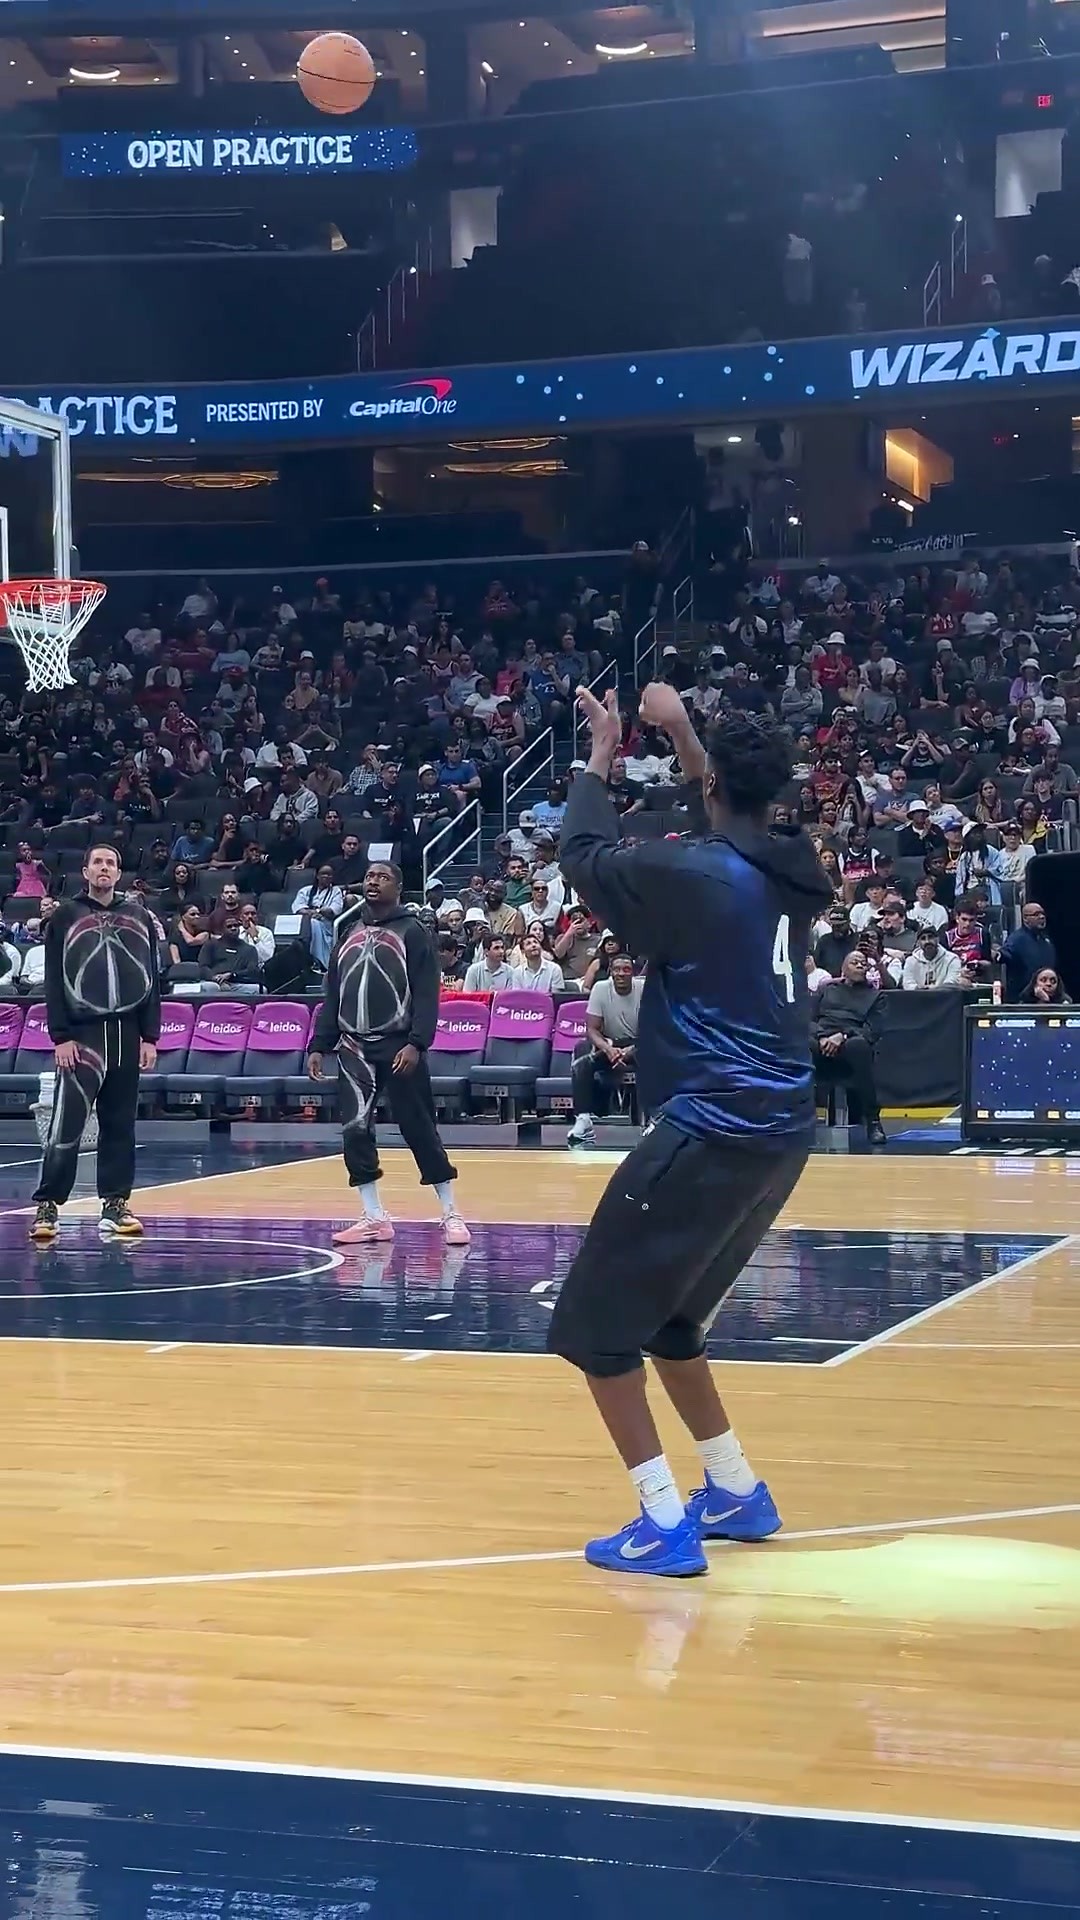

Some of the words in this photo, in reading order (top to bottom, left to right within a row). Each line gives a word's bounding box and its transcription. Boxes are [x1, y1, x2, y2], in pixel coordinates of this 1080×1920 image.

[127, 139, 203, 168] OPEN
[212, 136, 353, 166] PRACTICE
[206, 403, 299, 422] PRESENTED
[303, 399, 324, 418] BY
[772, 914, 796, 1003] 4
[510, 1009, 544, 1021] leidos
[210, 1023, 242, 1034] leidos
[269, 1021, 302, 1033] leidos
[448, 1021, 481, 1032] leidos
